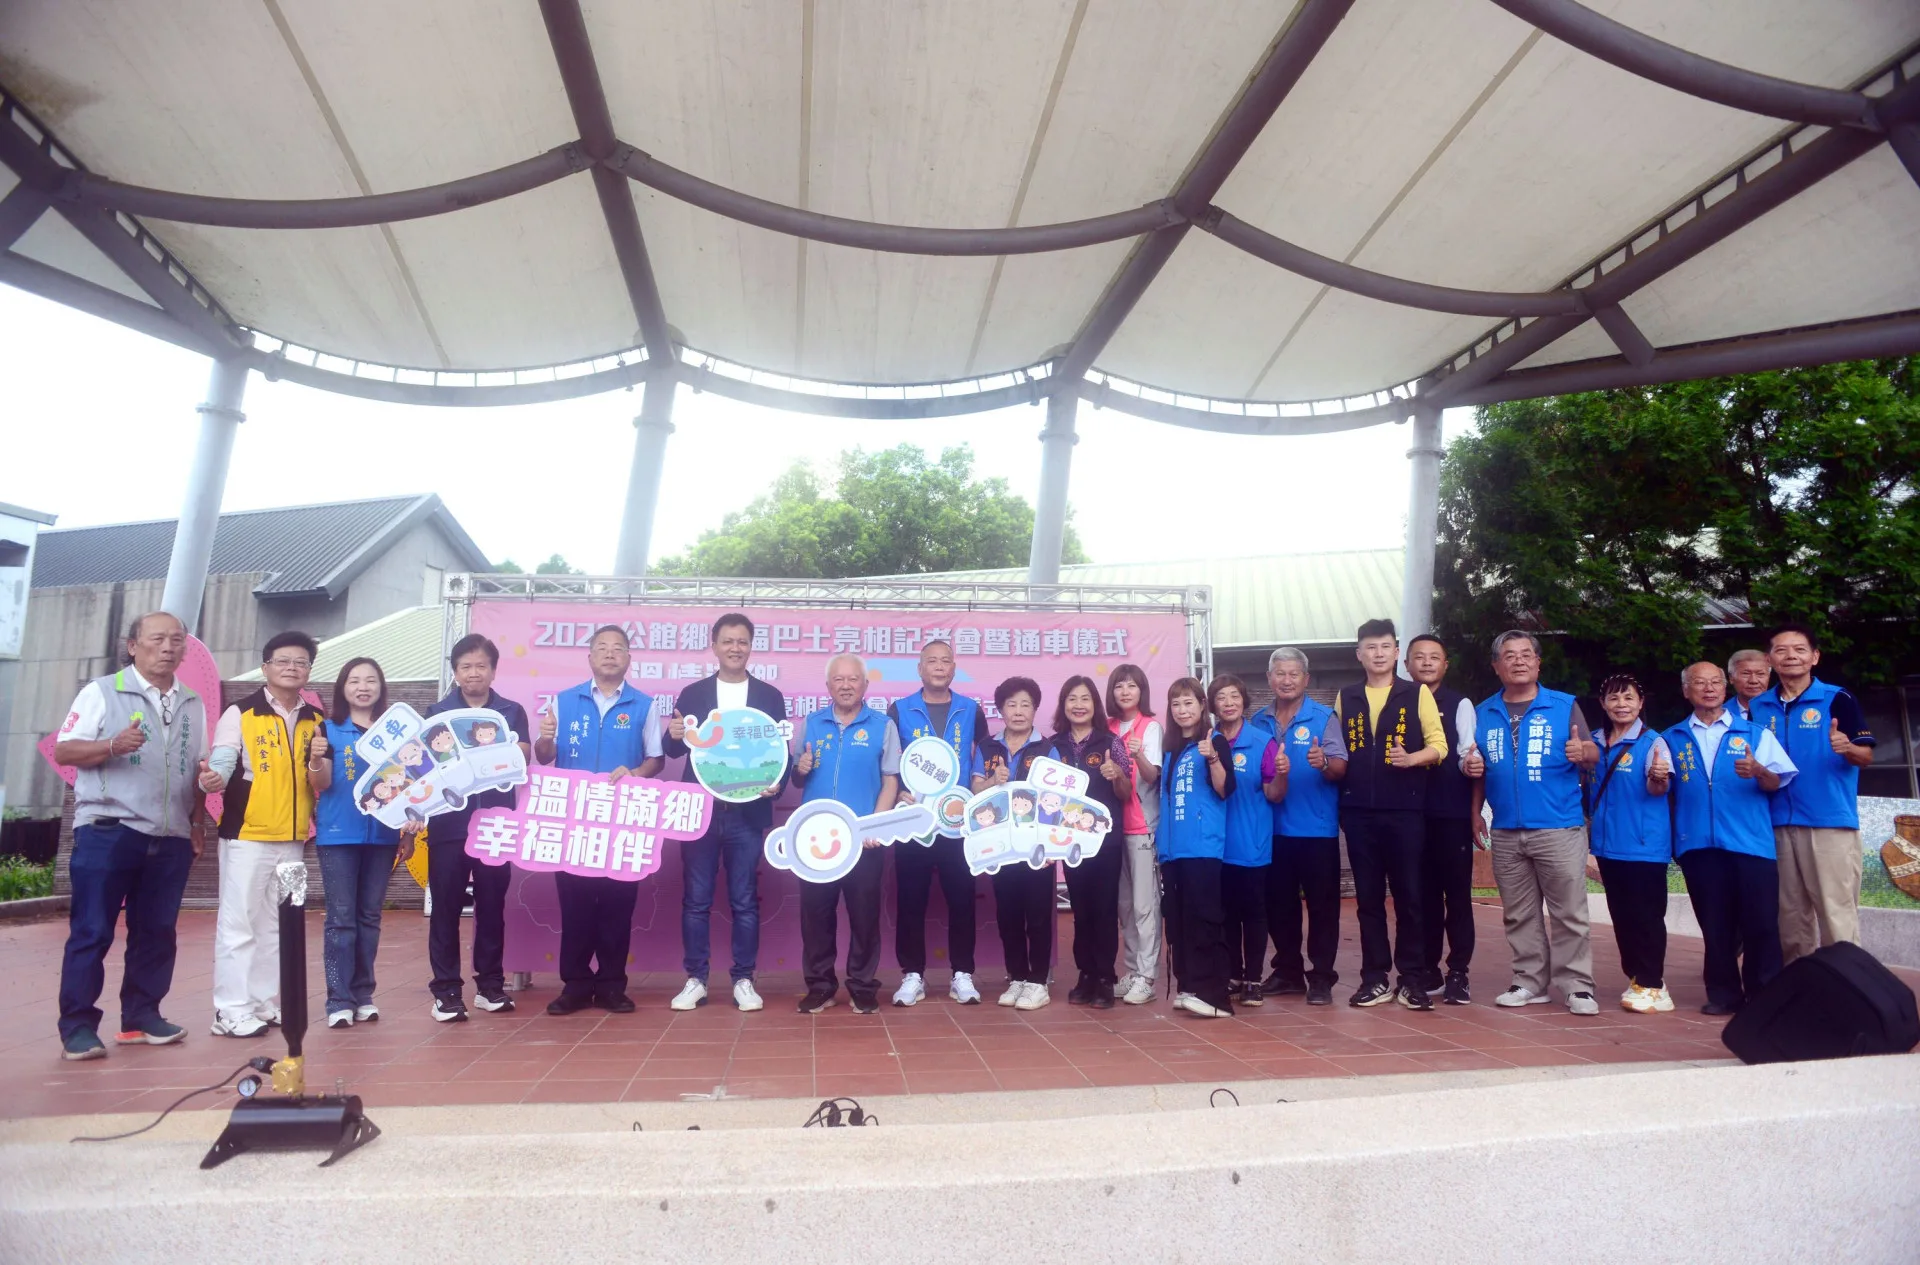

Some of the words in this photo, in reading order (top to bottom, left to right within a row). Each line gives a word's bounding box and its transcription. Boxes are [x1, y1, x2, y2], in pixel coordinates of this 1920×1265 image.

[369, 719, 408, 752] 甲車
[732, 724, 791, 741] 幸福巴士
[909, 752, 950, 784] 公館鄉
[1042, 767, 1077, 791] 乙車
[526, 774, 706, 833] 溫情滿鄉
[474, 815, 656, 873] 幸福相伴
